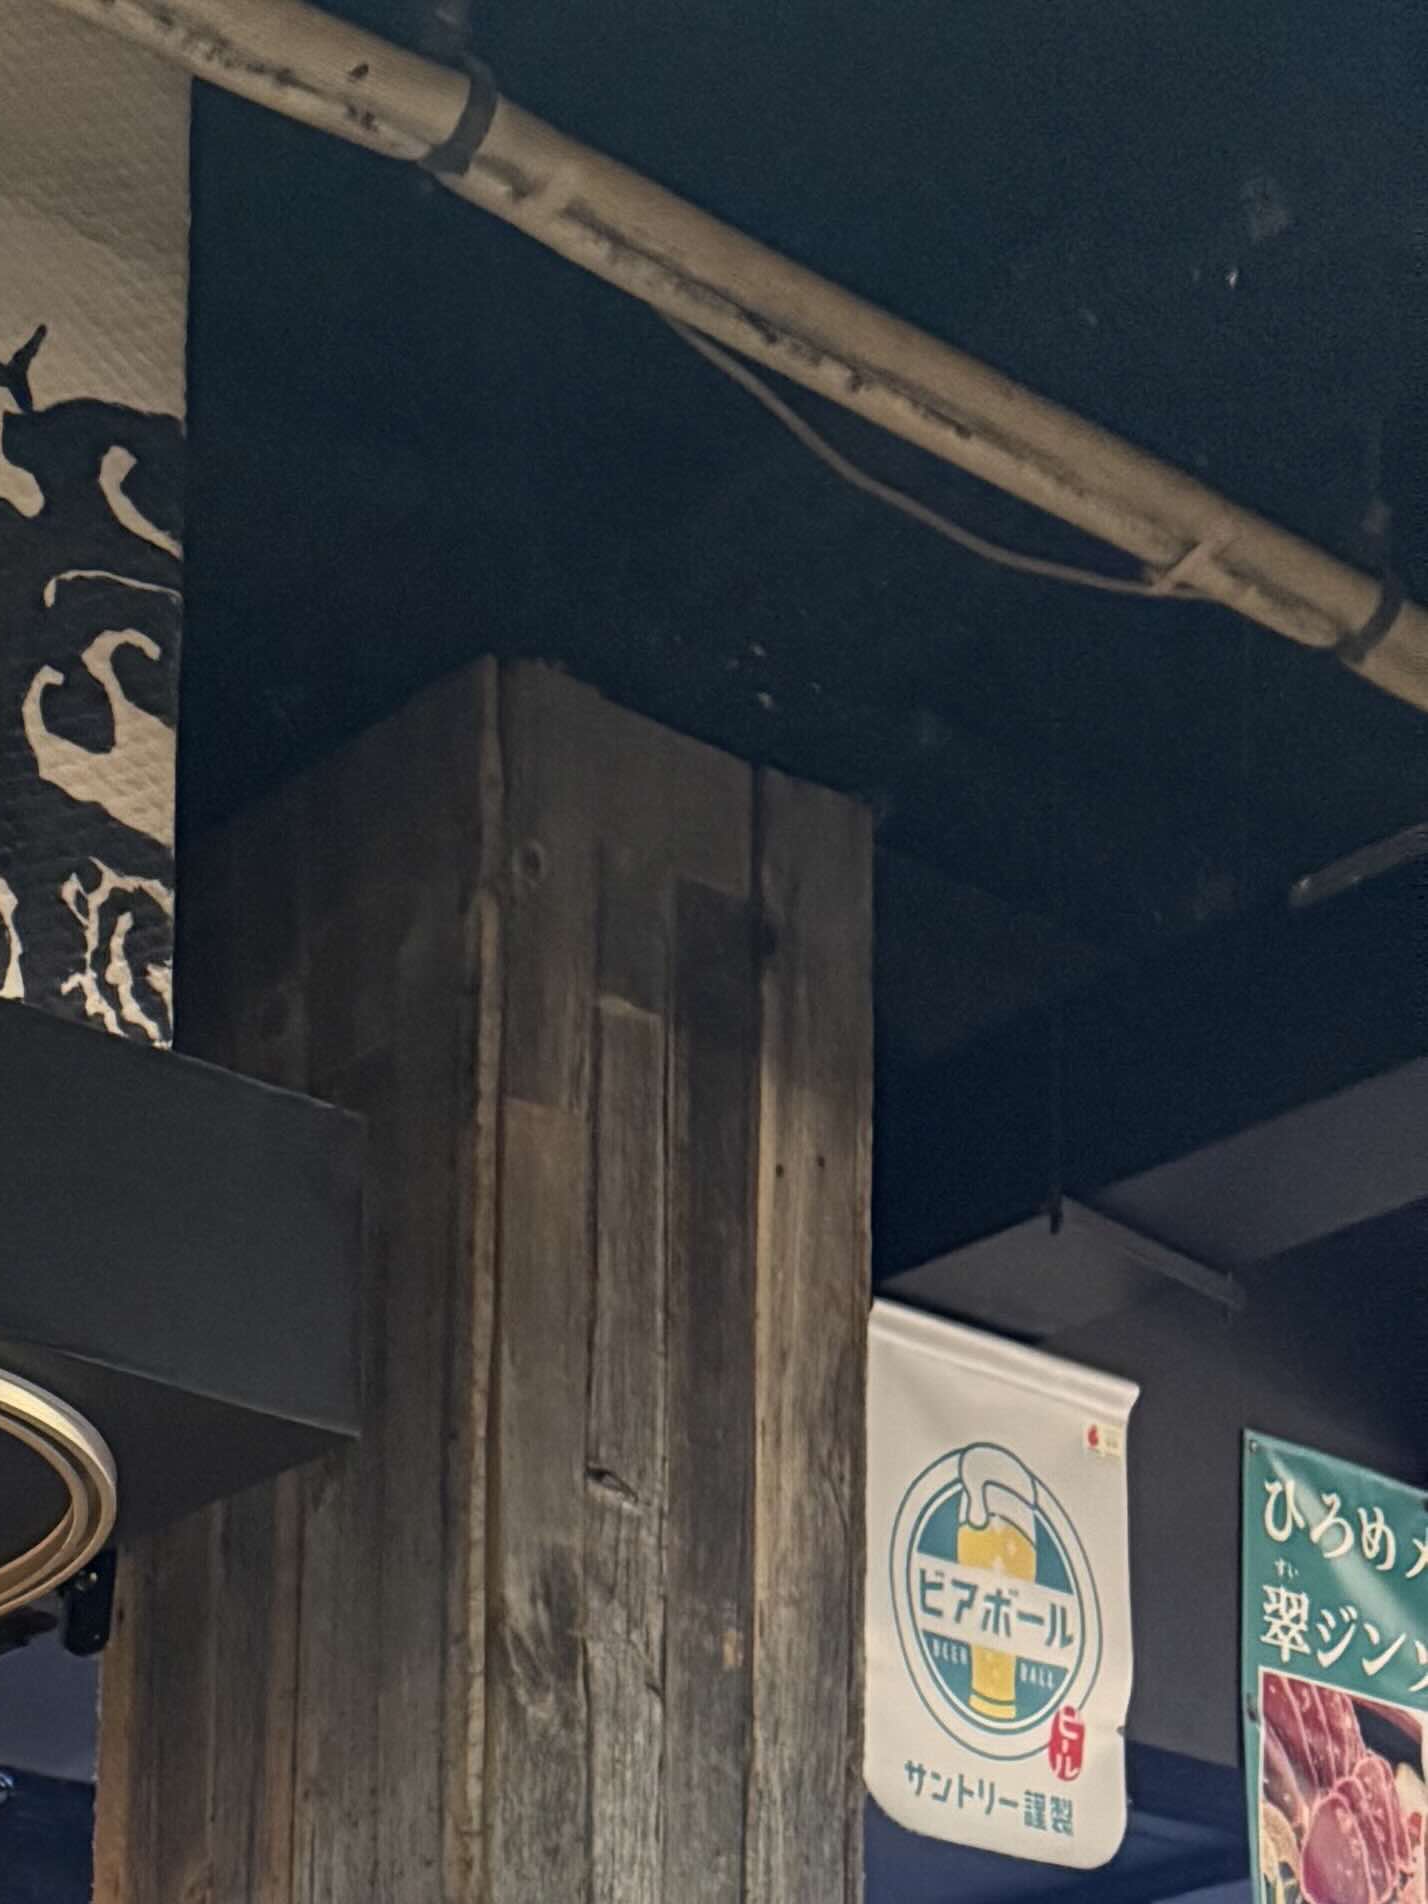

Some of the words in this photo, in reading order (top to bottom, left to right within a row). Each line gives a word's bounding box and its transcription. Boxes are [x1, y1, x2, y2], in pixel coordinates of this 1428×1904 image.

[1275, 1558, 1299, 1579] すい
[920, 1569, 1073, 1648] ビアボール
[931, 1639, 967, 1665] BEER
[1020, 1663, 1054, 1688] BALL
[1056, 1706, 1080, 1780] ビール
[904, 1760, 1074, 1837] サントリー謹製
